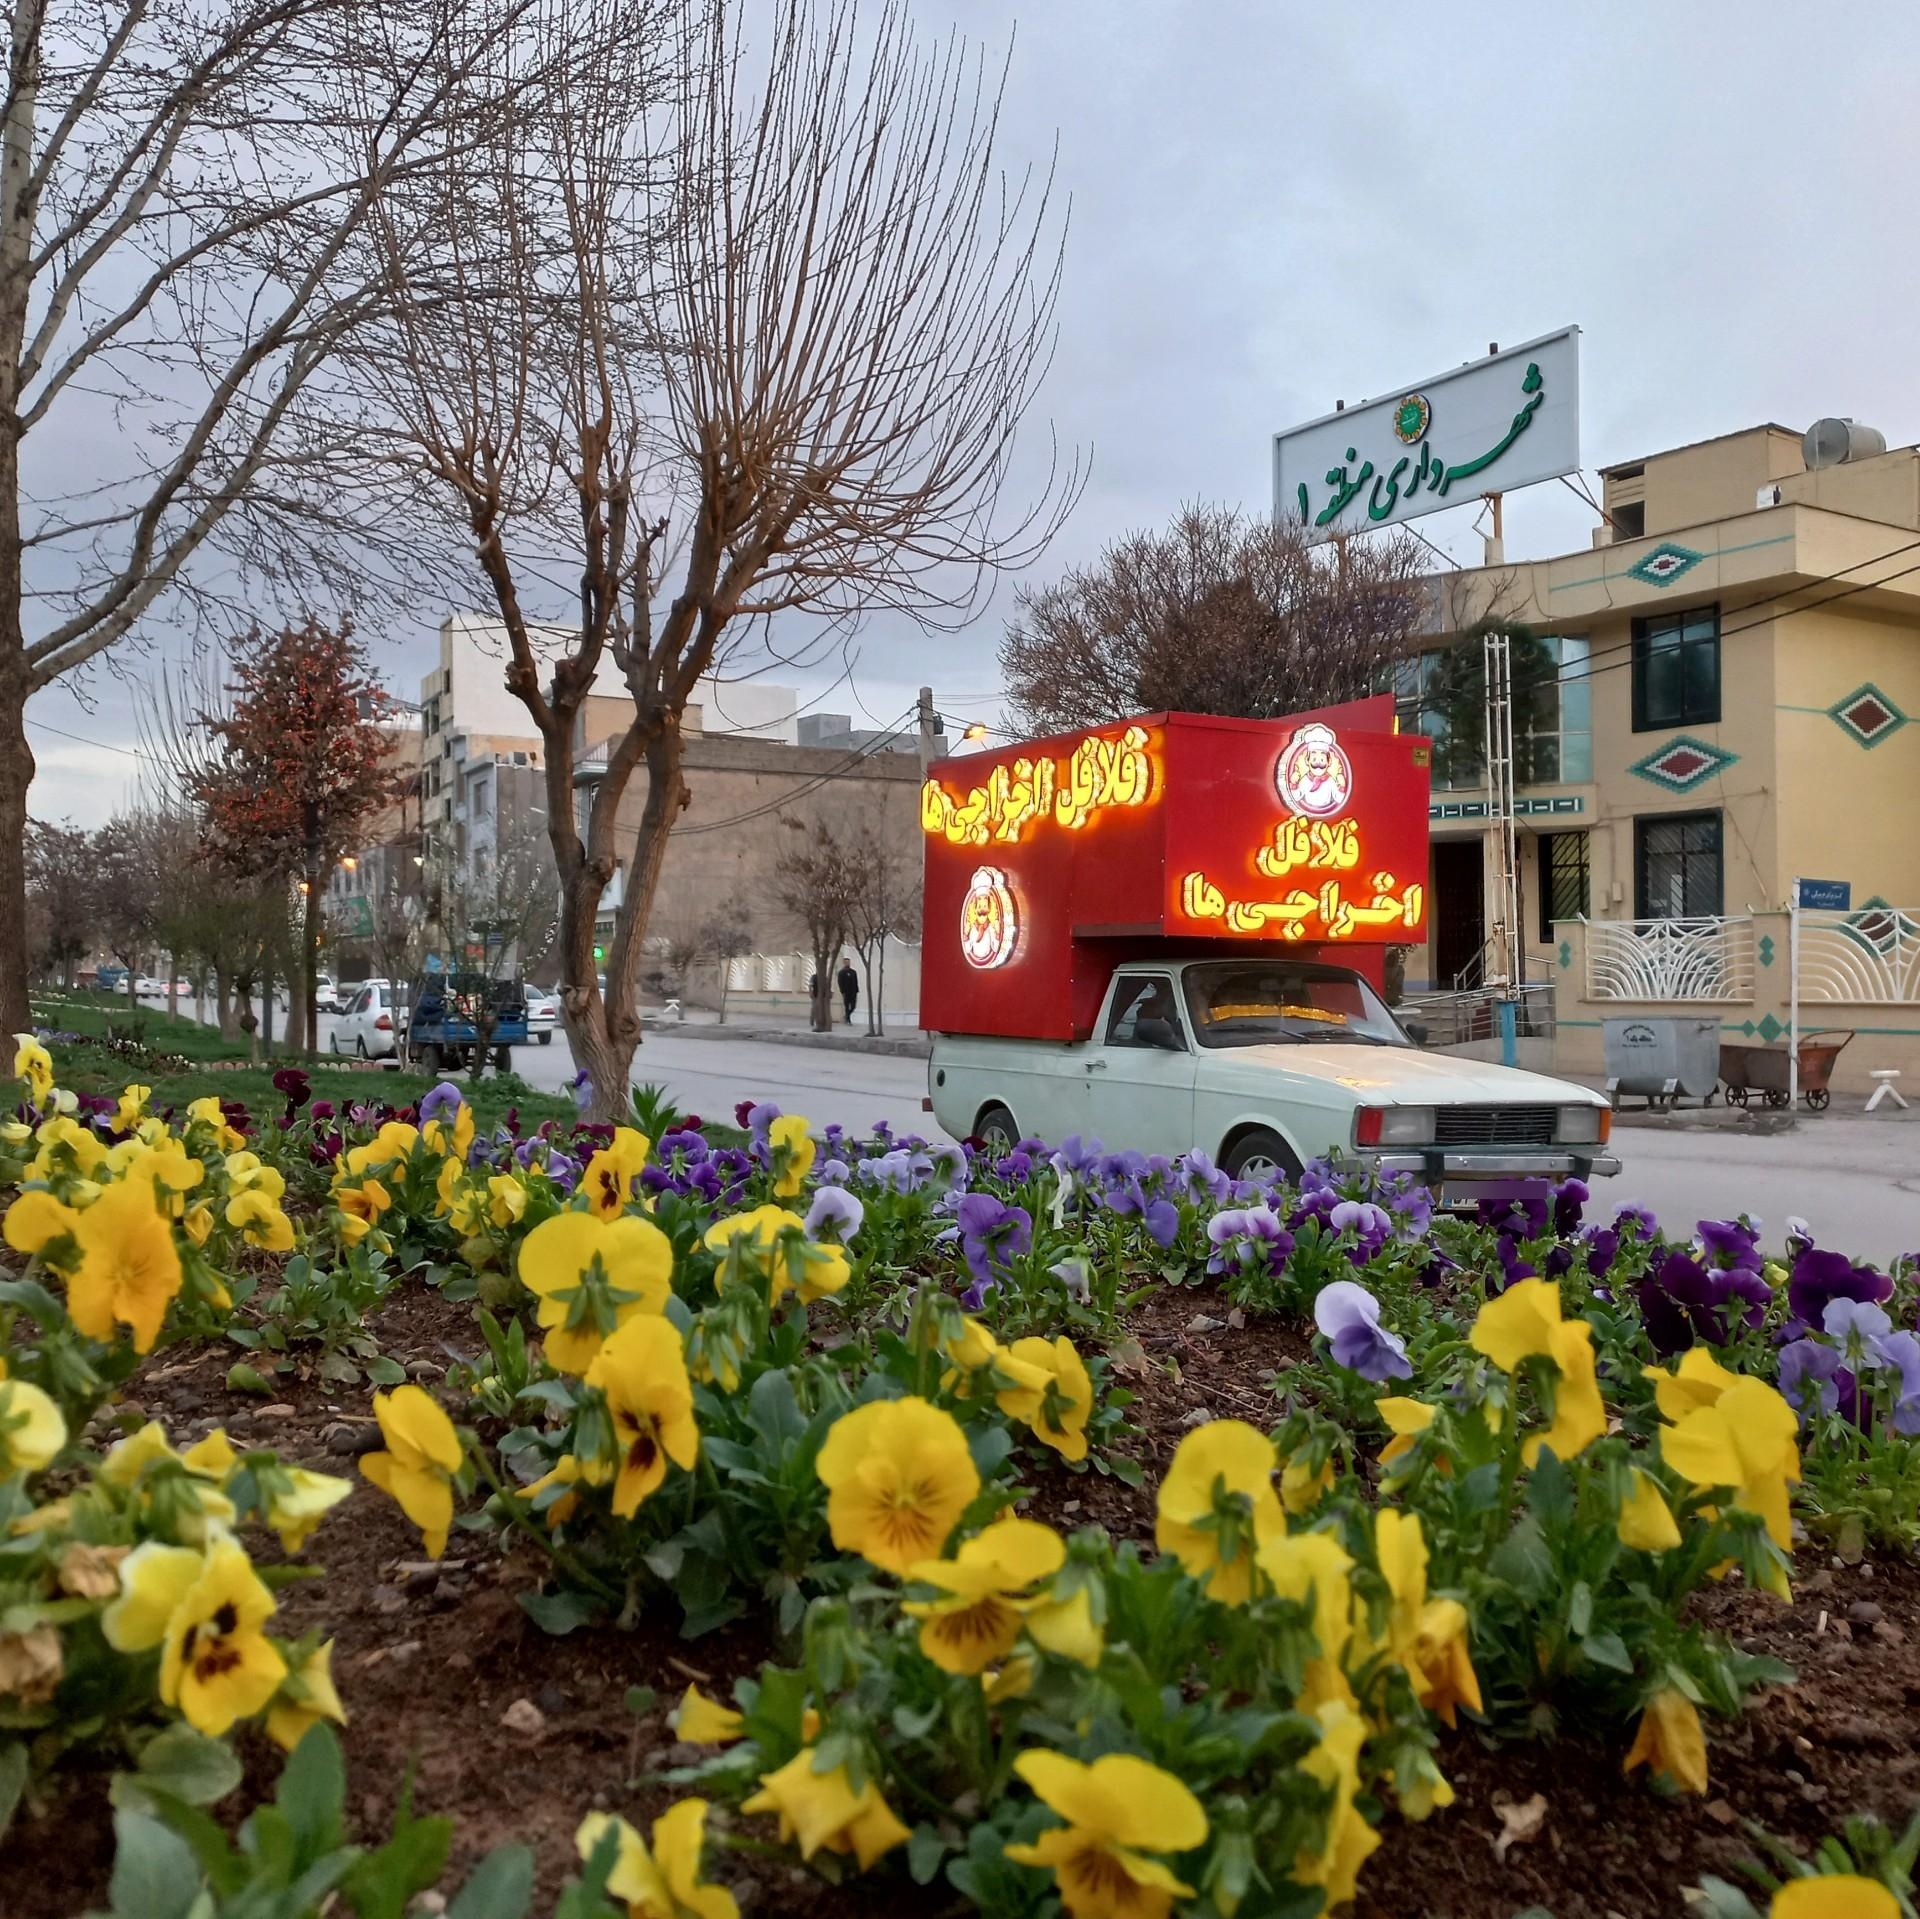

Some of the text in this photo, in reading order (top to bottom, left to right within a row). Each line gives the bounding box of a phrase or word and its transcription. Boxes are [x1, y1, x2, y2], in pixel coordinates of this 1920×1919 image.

[1314, 446, 1374, 527] منطقه
[1368, 361, 1545, 521] شهرداری
[1055, 726, 1150, 830] فلافل
[1254, 814, 1360, 878] فلافل
